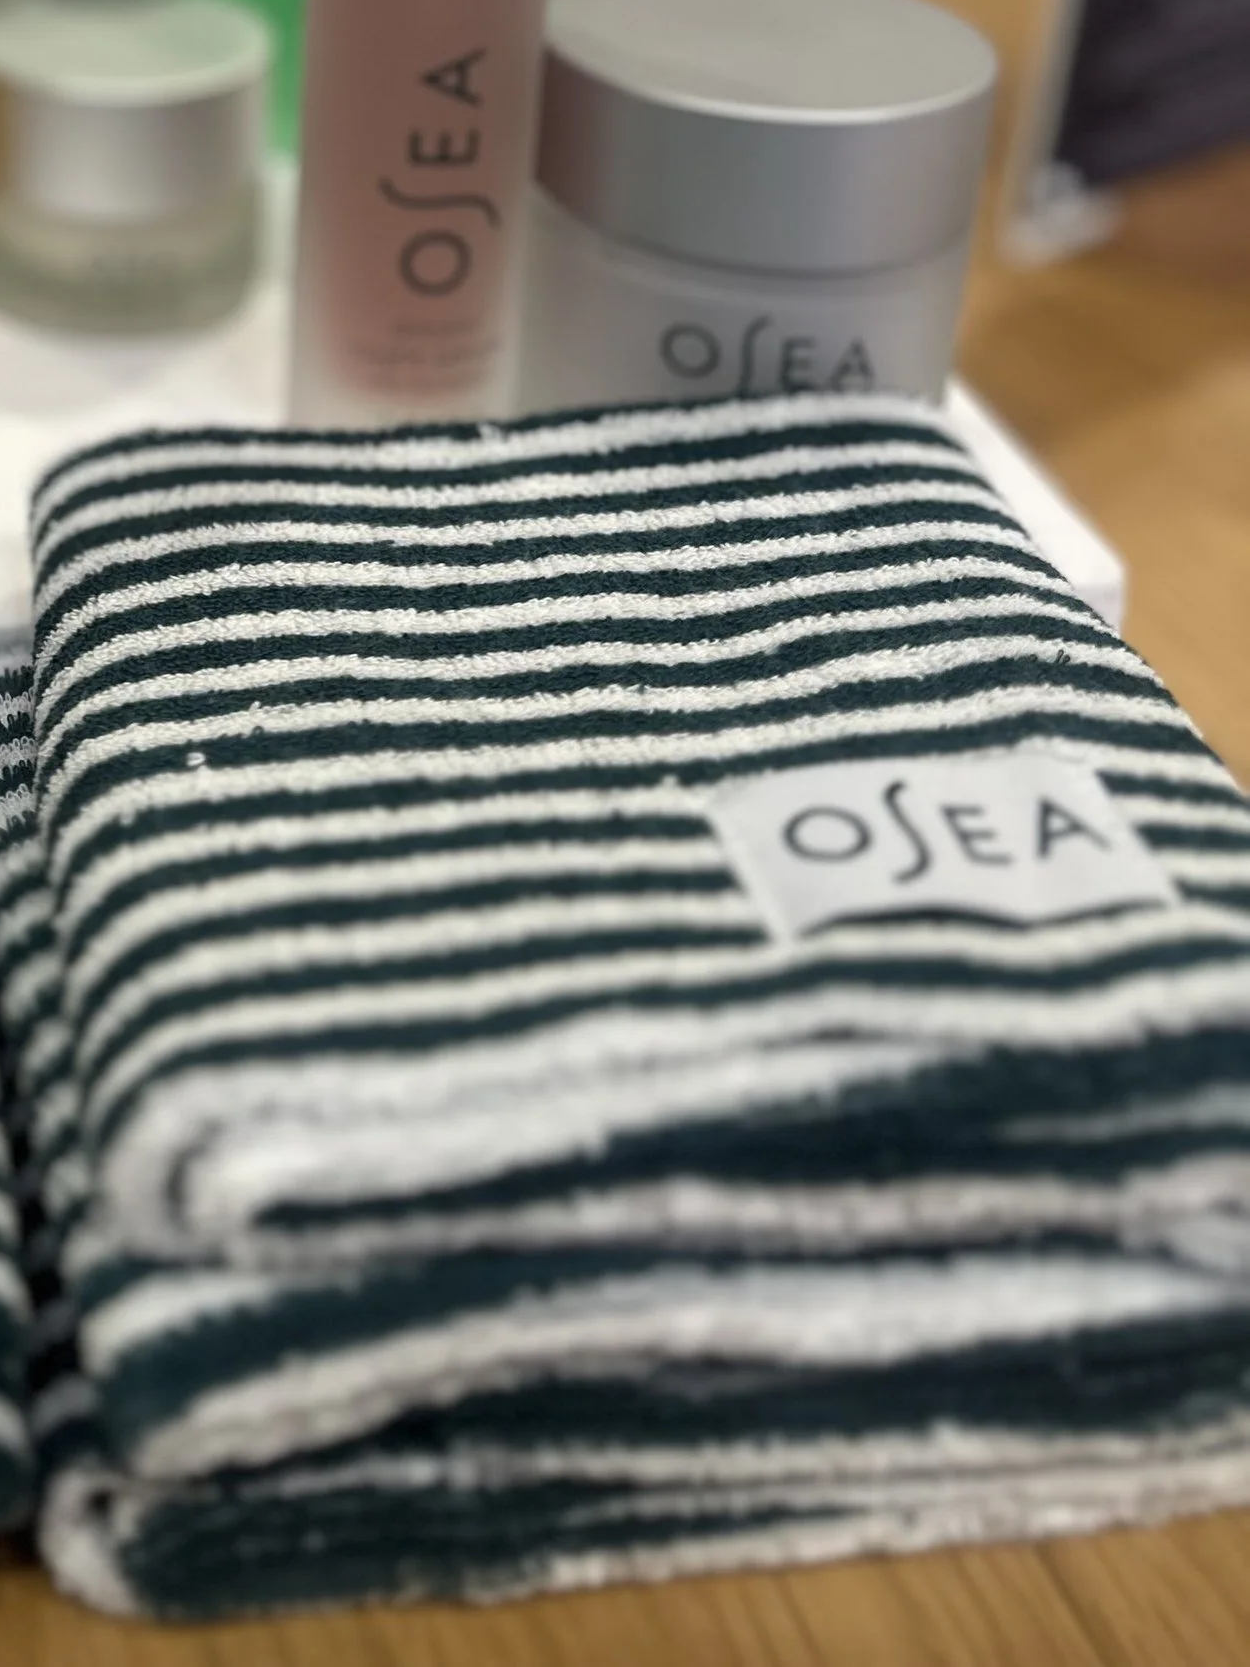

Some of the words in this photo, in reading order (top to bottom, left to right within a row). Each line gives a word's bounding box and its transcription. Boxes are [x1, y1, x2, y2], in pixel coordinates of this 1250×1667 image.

[378, 46, 502, 297] OSEA
[658, 314, 878, 398] OSEA
[783, 778, 1114, 885] OSEA
